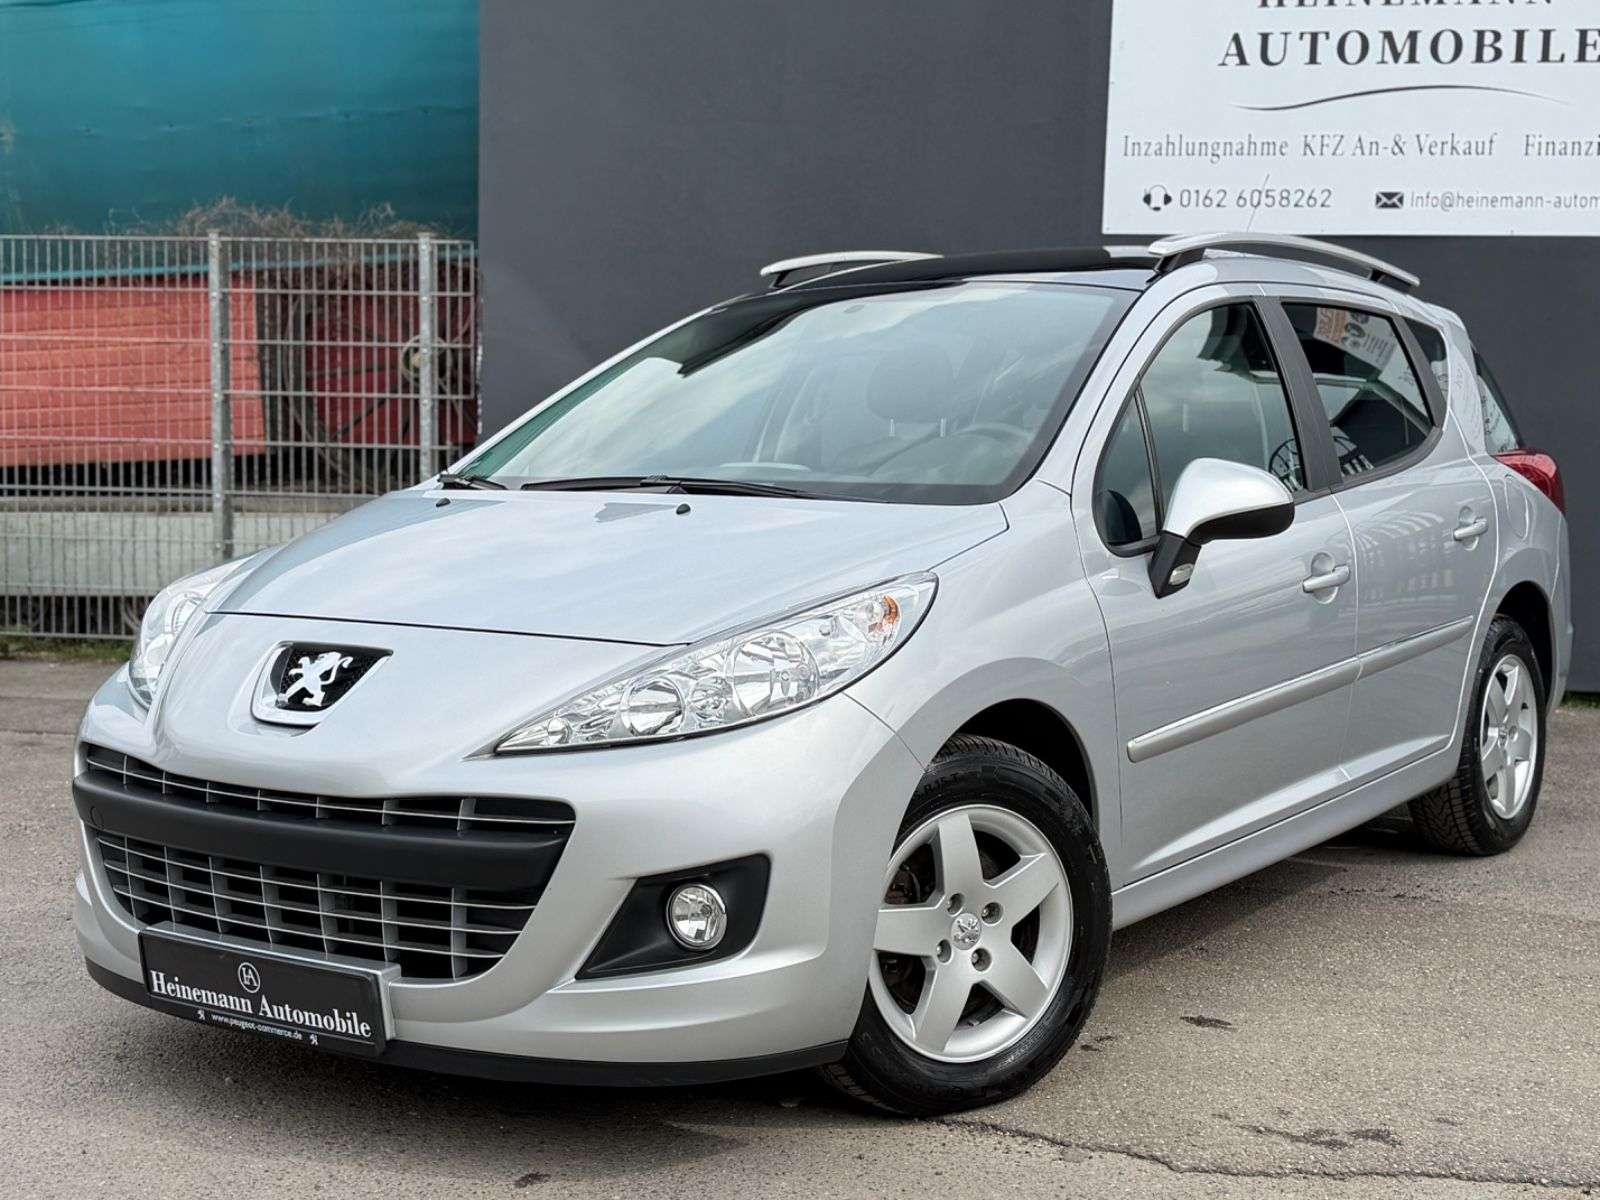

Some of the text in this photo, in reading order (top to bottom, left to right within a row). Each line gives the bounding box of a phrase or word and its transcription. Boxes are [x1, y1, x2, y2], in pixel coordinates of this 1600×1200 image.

[1218, 28, 1600, 67] AUTOMOBILE
[1123, 132, 1289, 164] Inzahlungnahme
[1302, 134, 1345, 157] KFZ
[1415, 131, 1498, 158] Verkauf
[1179, 188, 1333, 209] 0162 6058262
[150, 970, 372, 1038] Heinemann Automobile
